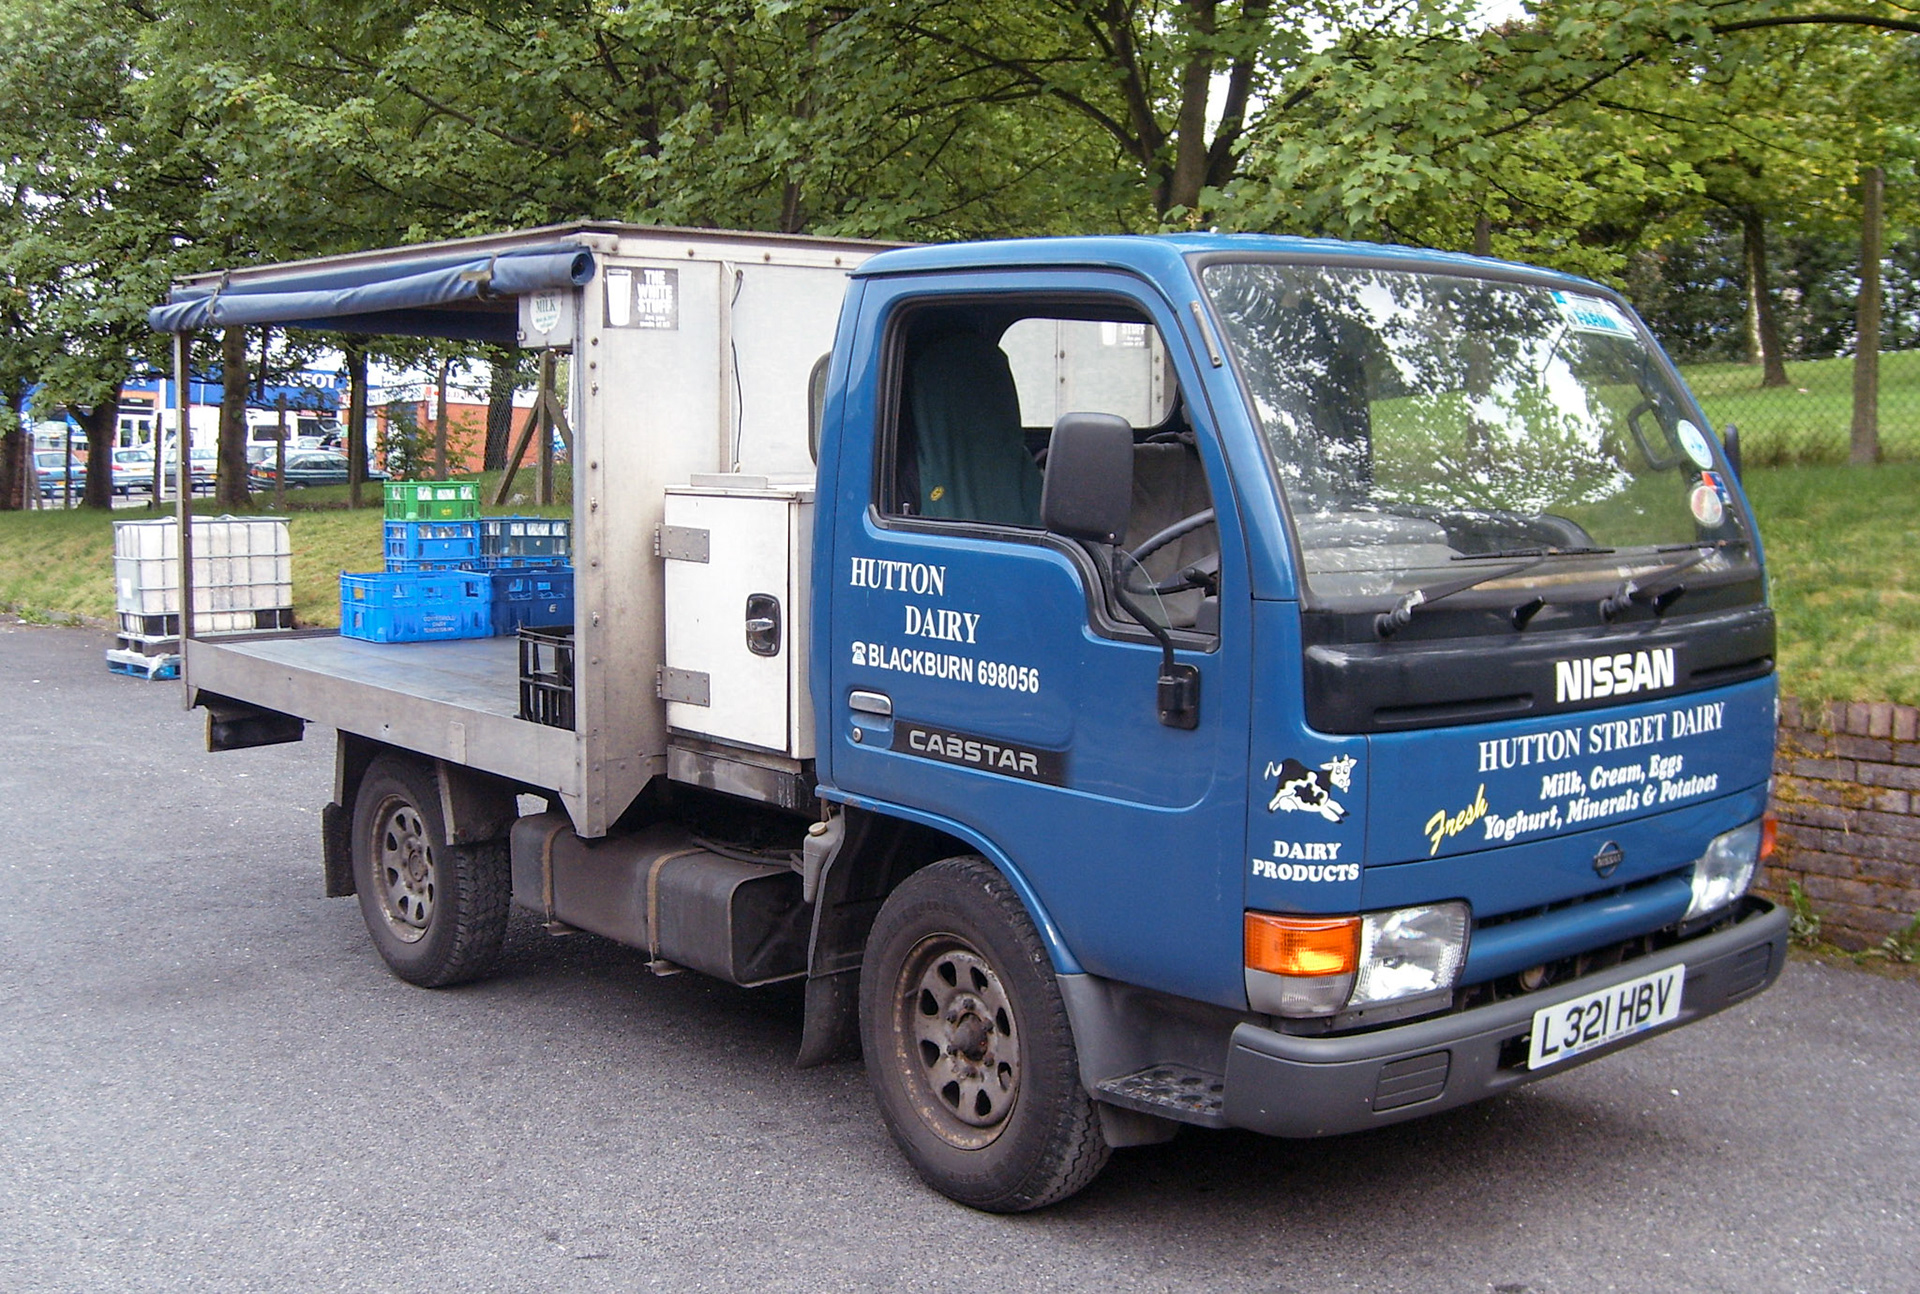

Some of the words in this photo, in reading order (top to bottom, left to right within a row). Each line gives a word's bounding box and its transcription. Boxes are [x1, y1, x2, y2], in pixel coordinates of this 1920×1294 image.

[637, 283, 673, 300] WHITE
[643, 270, 666, 285] THE
[535, 299, 556, 313] MILK
[637, 298, 672, 314] STUFF
[850, 557, 947, 597] HUTTON
[904, 605, 981, 644] DAIRY
[868, 643, 974, 683] BLACKBURN
[977, 660, 1040, 694] 698056
[1556, 648, 1675, 703] NISSAN
[909, 729, 1039, 776] CABSTAR
[1478, 727, 1583, 773] HUTTON
[1589, 713, 1667, 755] STREET
[1672, 702, 1725, 740] DAIRY
[1540, 770, 1587, 800] Milk,
[1590, 762, 1646, 791] Cream,
[1649, 753, 1684, 781] Eggs
[1424, 783, 1489, 857] Fresh
[1483, 805, 1563, 842] Yoghurt,
[1566, 788, 1640, 824] Minerals
[1642, 785, 1658, 807] &
[1659, 772, 1719, 804] Potatoes
[1252, 858, 1360, 882] PRODUCTS
[1273, 840, 1342, 860] DAIRY
